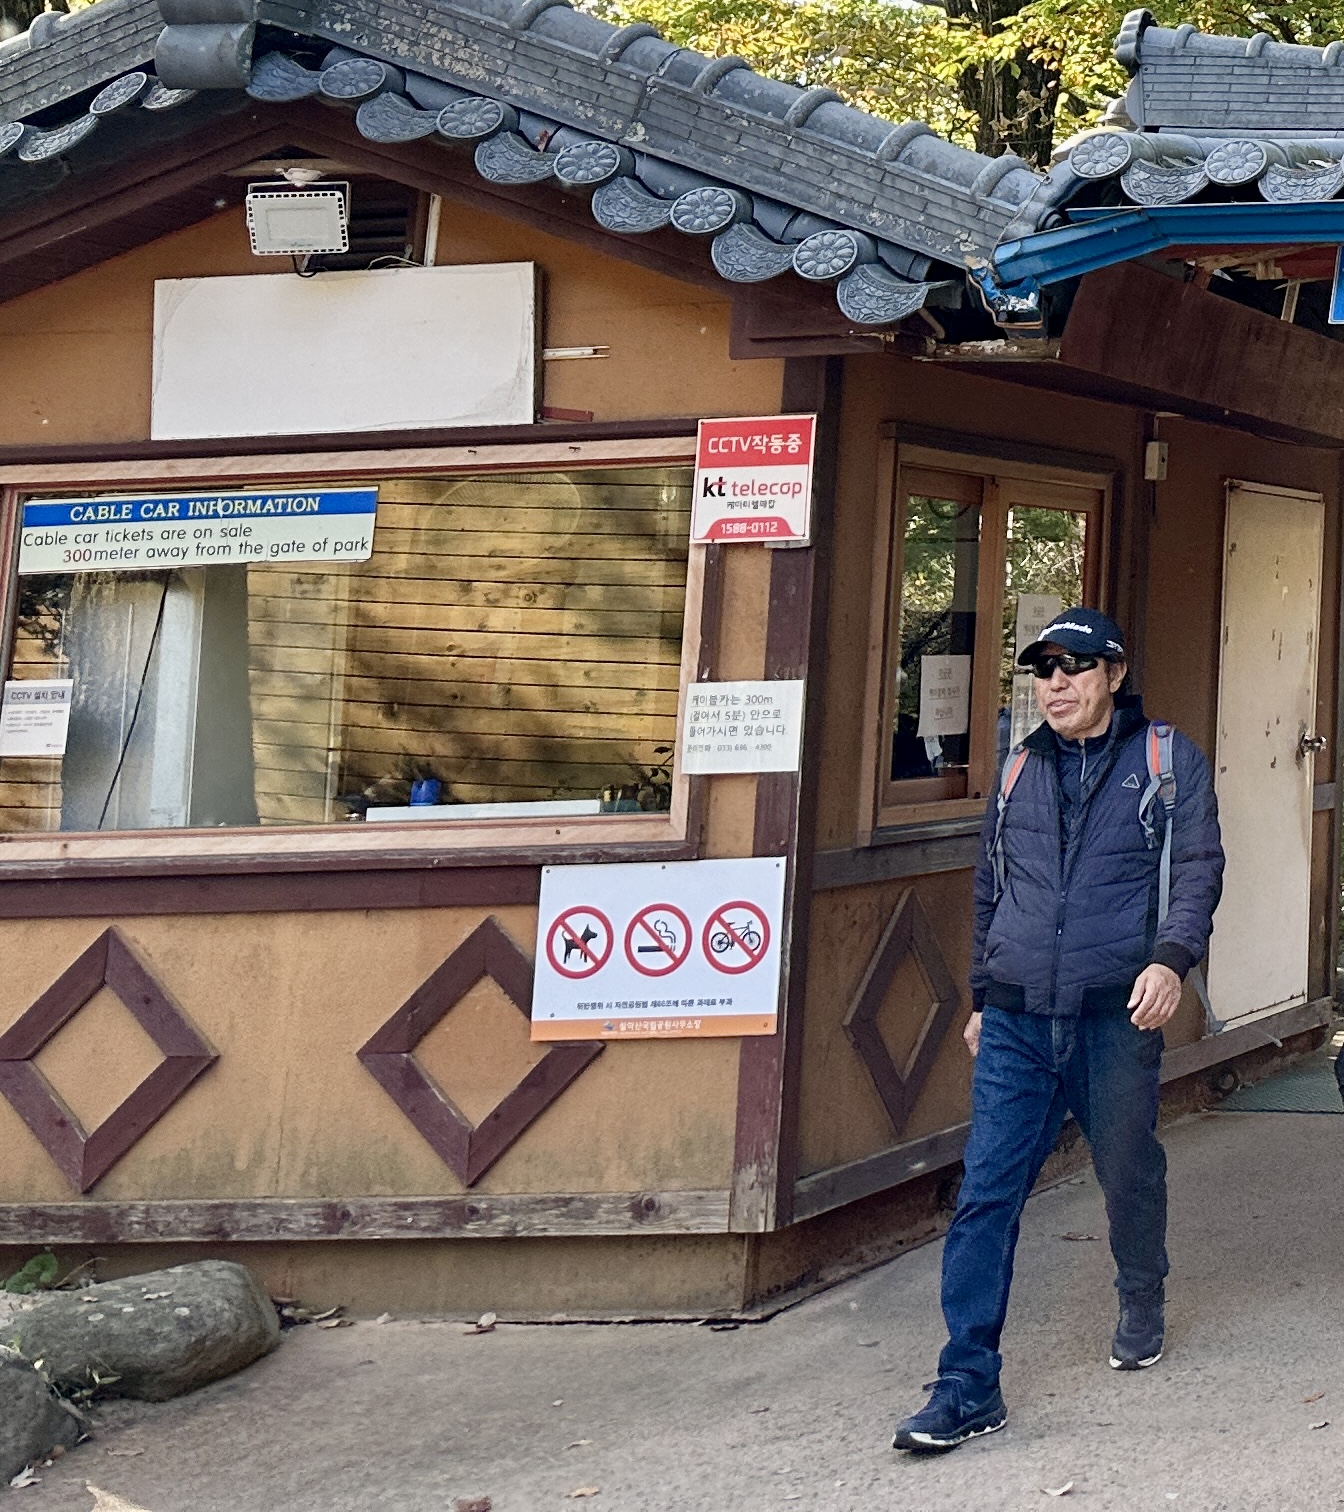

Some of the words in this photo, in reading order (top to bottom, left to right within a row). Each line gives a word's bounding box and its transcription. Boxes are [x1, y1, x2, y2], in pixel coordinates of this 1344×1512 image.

[708, 433, 803, 454] CCTV작동중
[703, 476, 727, 498] kt
[731, 478, 803, 499] telecop
[70, 503, 133, 522] CABLE
[140, 502, 180, 518] CAR
[187, 497, 321, 517] INFORMATION
[23, 531, 68, 547] Cable
[74, 533, 99, 545] car
[105, 528, 154, 543] tickets
[160, 528, 187, 540] are
[193, 527, 213, 539] on
[220, 523, 253, 538] sale
[721, 521, 778, 535] 1588-0112
[146, 546, 189, 560] away
[195, 542, 232, 556] from
[238, 540, 264, 555] the
[269, 540, 306, 558] gate
[312, 538, 329, 553] of
[333, 537, 369, 555] park
[11, 691, 32, 701] CCTV
[692, 694, 741, 706] 케이블카는
[745, 694, 773, 705] 300m
[750, 709, 781, 721] 안으로
[689, 725, 738, 738] 들어가시면
